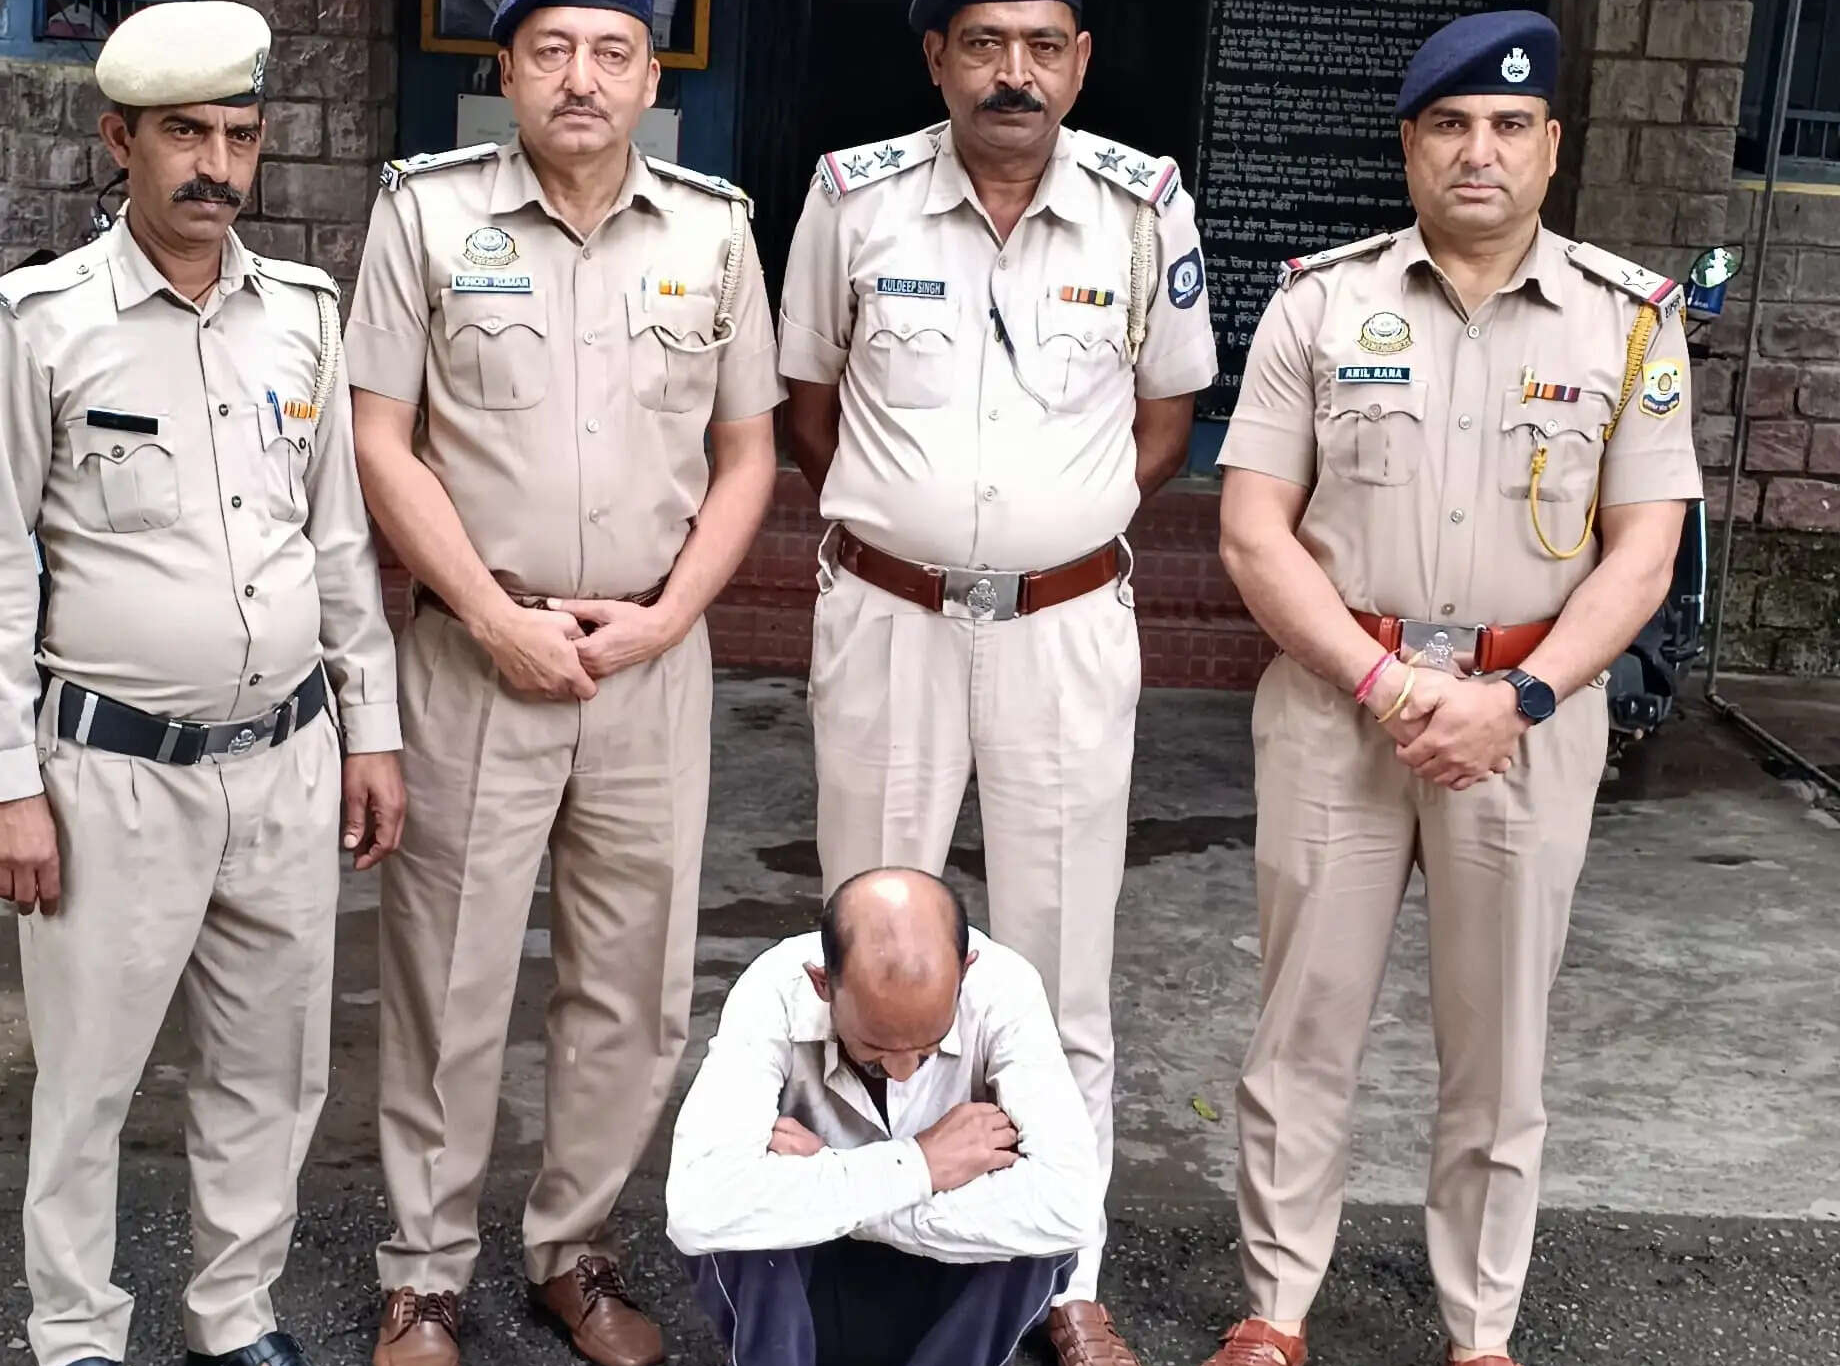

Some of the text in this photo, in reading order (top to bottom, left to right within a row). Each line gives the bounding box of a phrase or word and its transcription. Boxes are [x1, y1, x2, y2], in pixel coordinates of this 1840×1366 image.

[882, 278, 941, 295] KULDEEP SINGH
[1345, 367, 1403, 379] ANIL RANA
